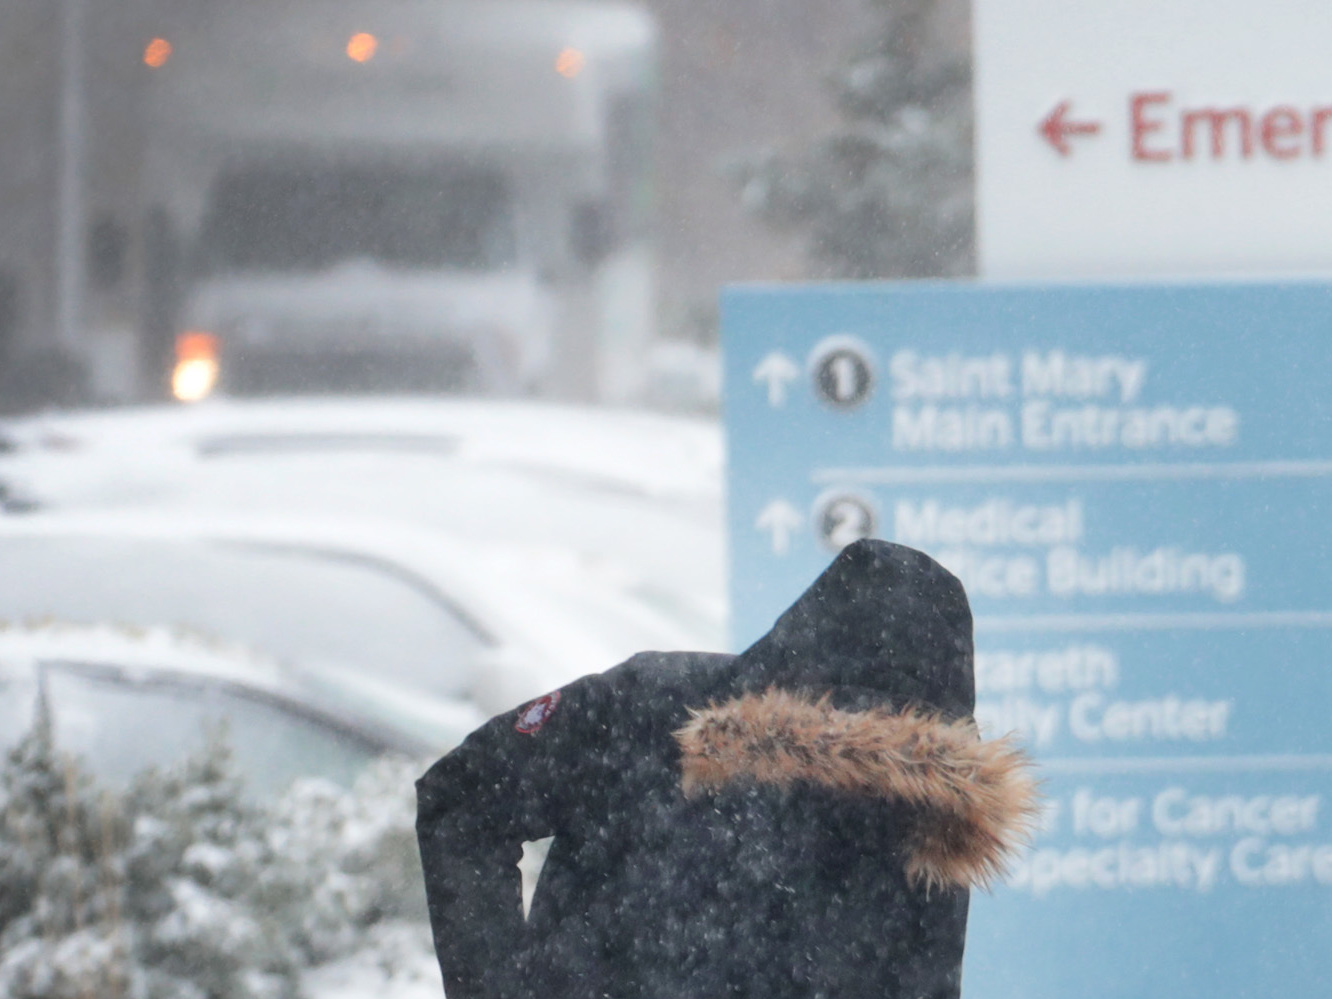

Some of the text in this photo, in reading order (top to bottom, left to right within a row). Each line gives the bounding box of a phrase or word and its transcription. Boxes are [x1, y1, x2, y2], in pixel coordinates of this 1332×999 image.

[831, 356, 856, 402] 1
[890, 347, 1145, 403] Saint Mary
[892, 399, 1238, 451] Main Entrance
[830, 503, 862, 548] 2
[897, 501, 1082, 545] Medical
[1048, 547, 1244, 600] Building
[1068, 693, 1230, 741] Center
[1072, 790, 1139, 835] for
[1153, 786, 1321, 836] Cancer
